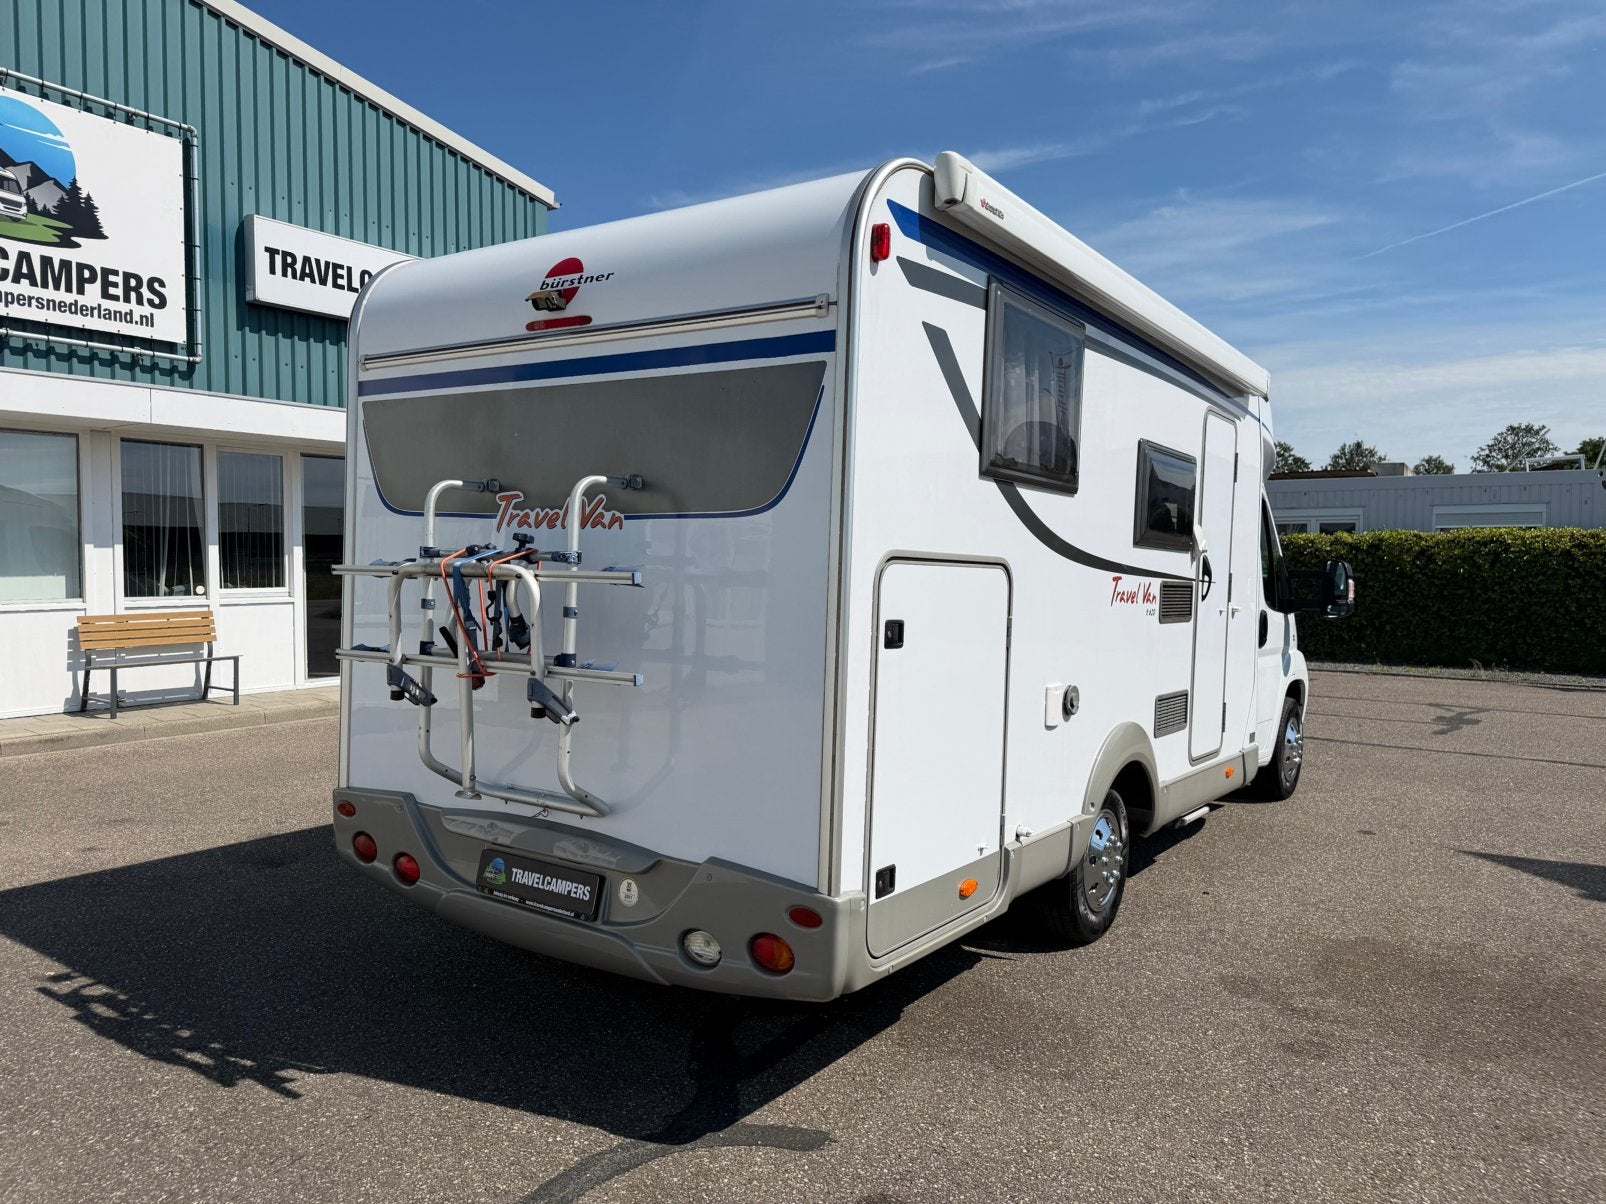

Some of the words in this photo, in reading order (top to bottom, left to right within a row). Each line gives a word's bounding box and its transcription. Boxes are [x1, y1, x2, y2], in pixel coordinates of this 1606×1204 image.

[540, 272, 615, 290] bürstner
[0, 289, 155, 328] persnederland.nl
[496, 493, 570, 533] Travel
[580, 495, 624, 530] Van
[1110, 576, 1141, 607] Travel
[1142, 581, 1157, 604] Van
[511, 867, 591, 901] TRAVELCAMPERS
